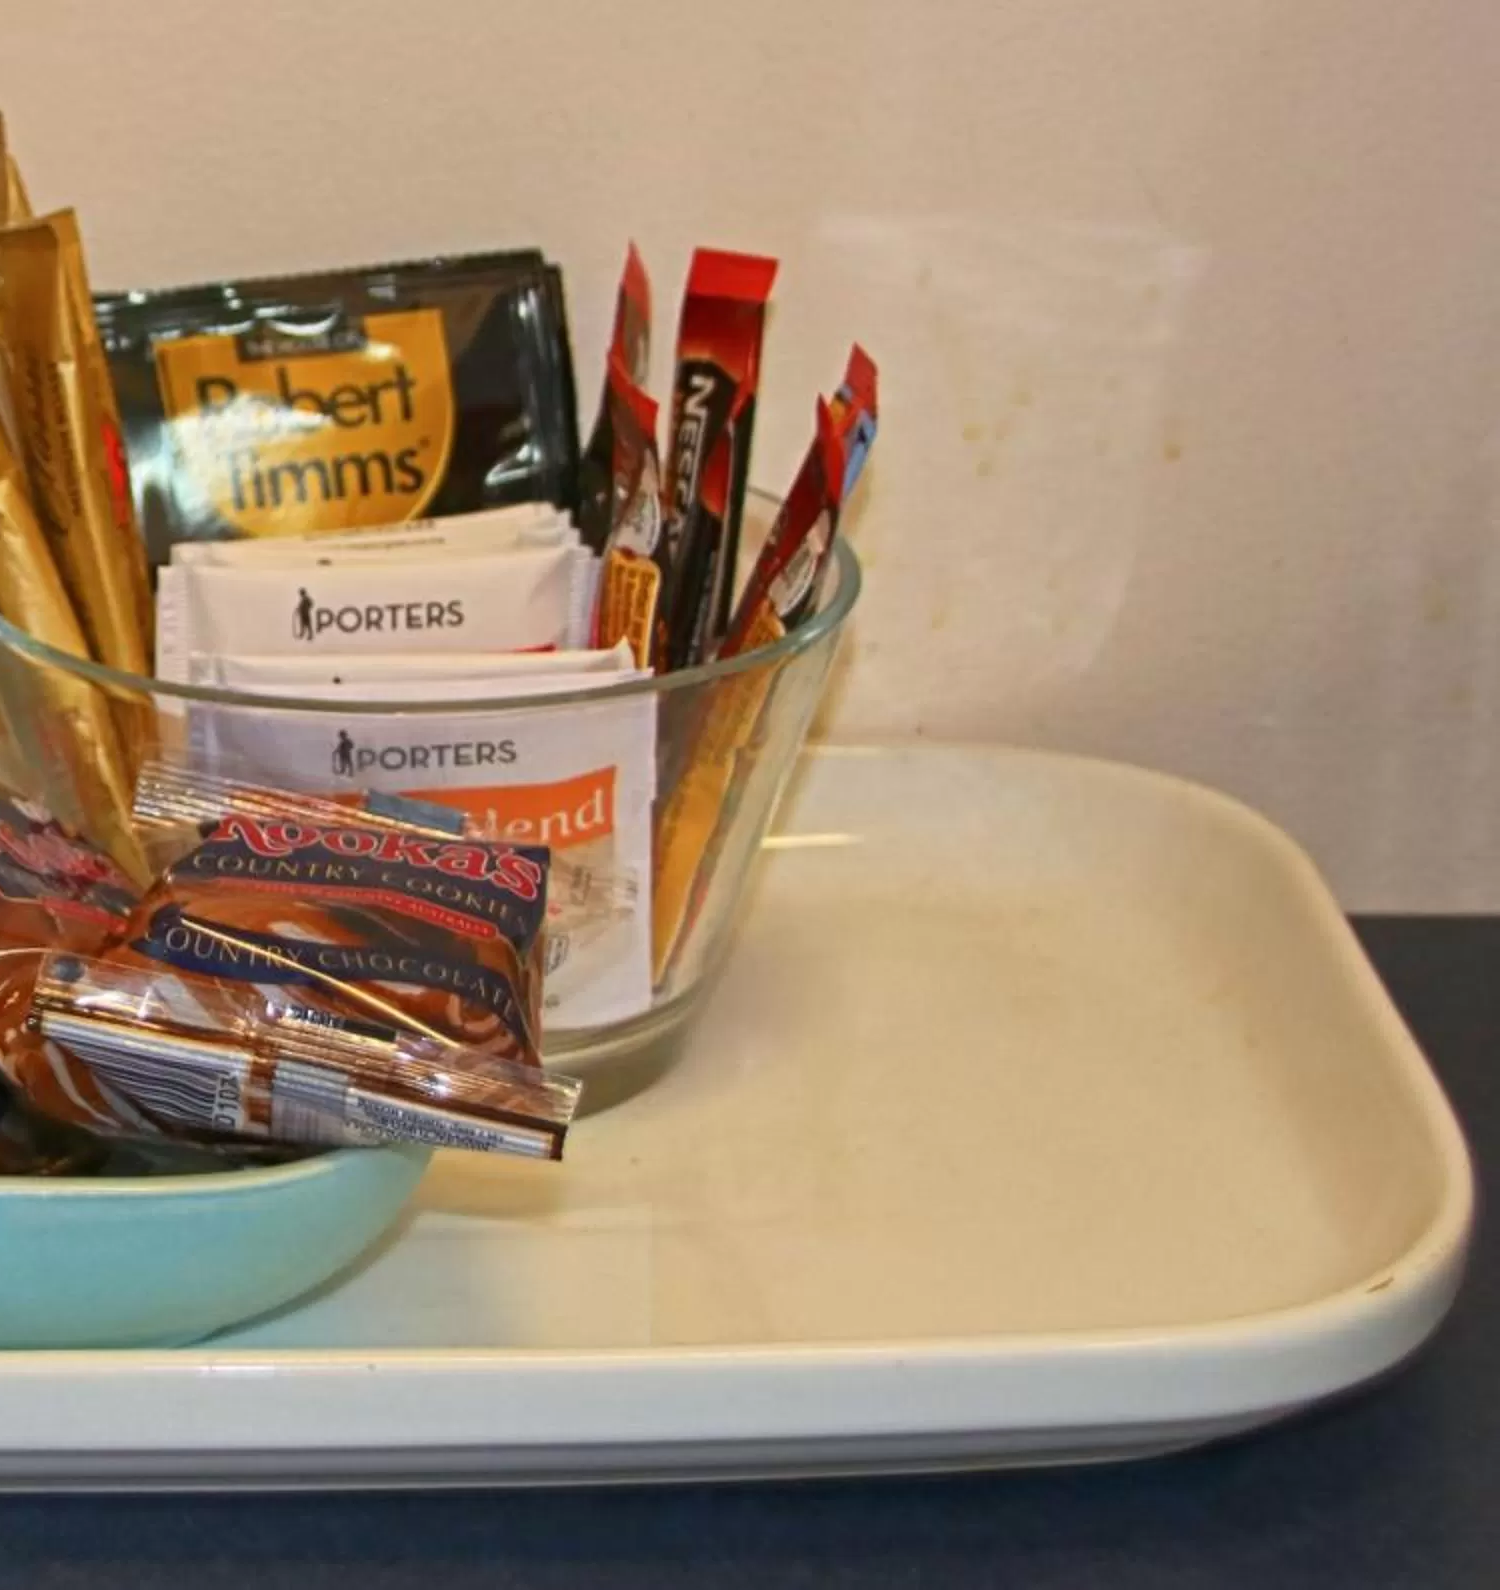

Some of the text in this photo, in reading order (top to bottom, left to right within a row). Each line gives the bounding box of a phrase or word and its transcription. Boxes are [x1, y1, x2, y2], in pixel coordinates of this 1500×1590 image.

[195, 364, 416, 430] Rbert
[315, 600, 464, 634] PORTERS
[356, 740, 517, 772] PORTERS
[192, 852, 368, 884] COUNTRY
[145, 925, 302, 970] OUNTRY
